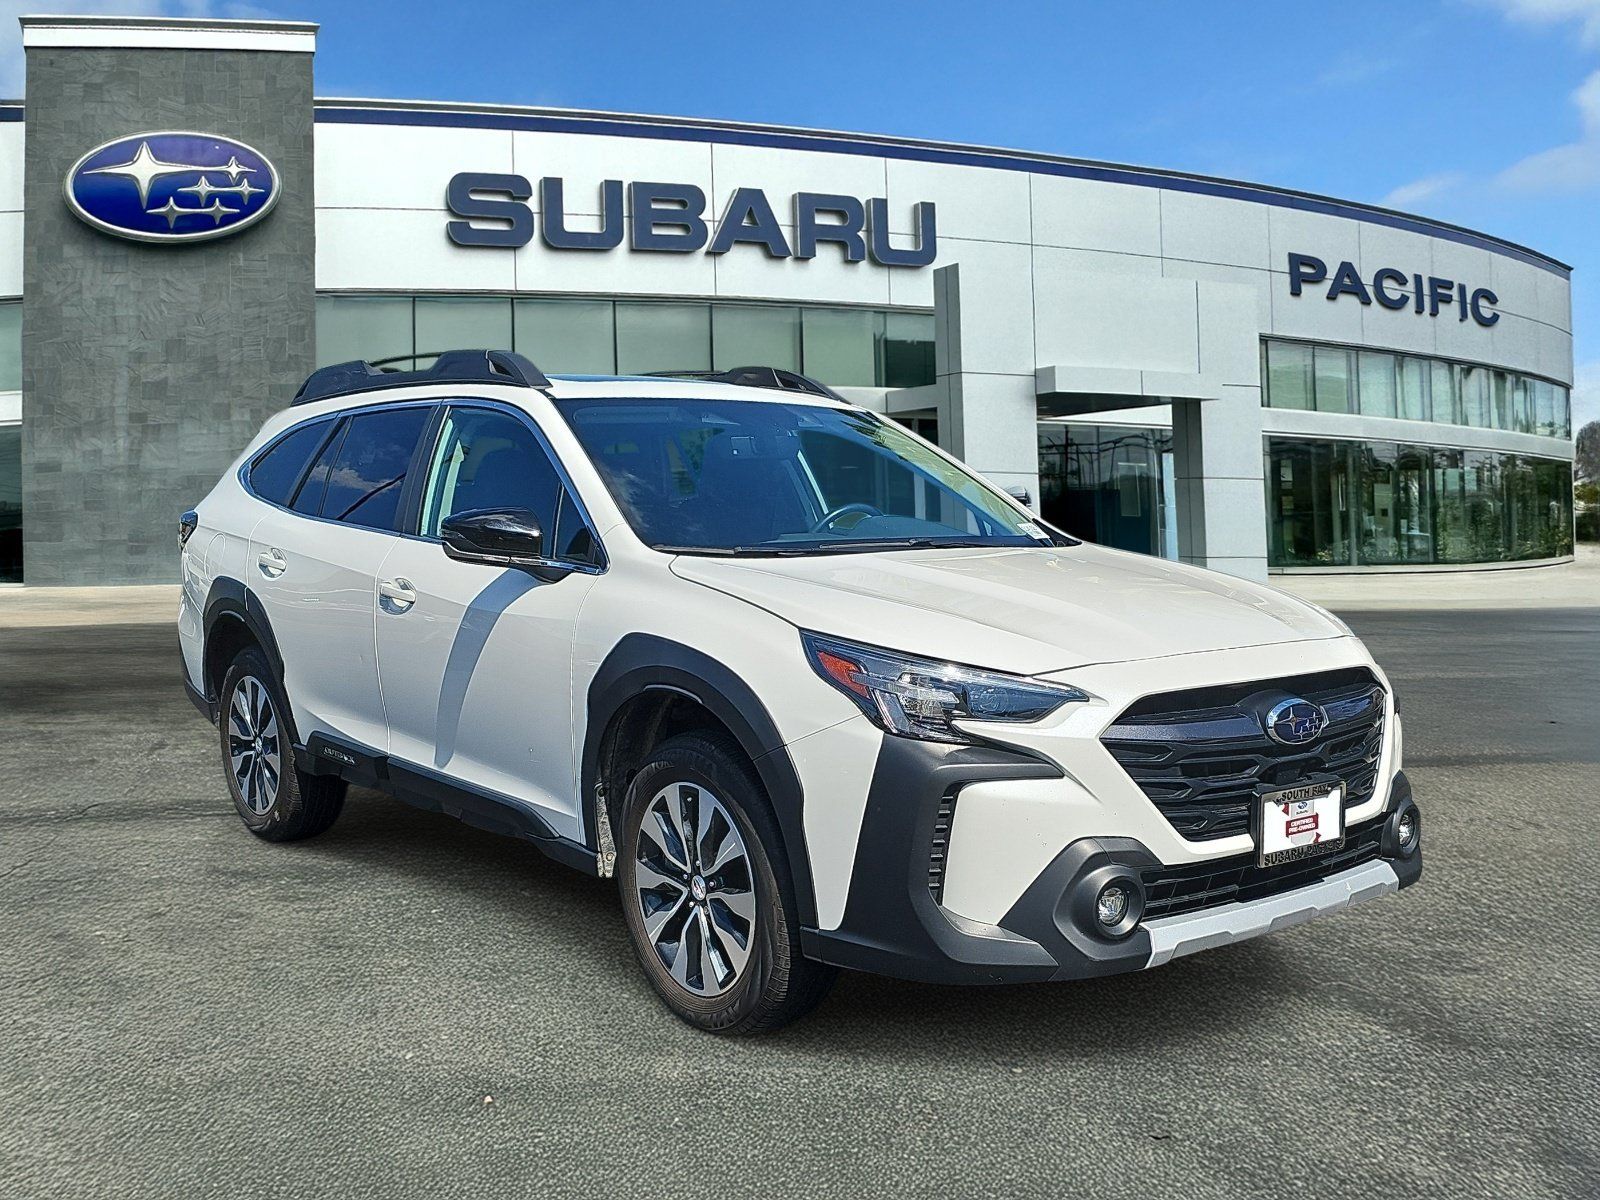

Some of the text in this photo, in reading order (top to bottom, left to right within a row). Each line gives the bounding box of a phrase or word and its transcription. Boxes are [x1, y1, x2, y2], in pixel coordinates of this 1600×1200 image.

[446, 171, 937, 268] SUBARU
[1288, 252, 1500, 326] PACIFIC
[1281, 788, 1310, 802] SOUTH
[1264, 847, 1304, 866] SUBARU
